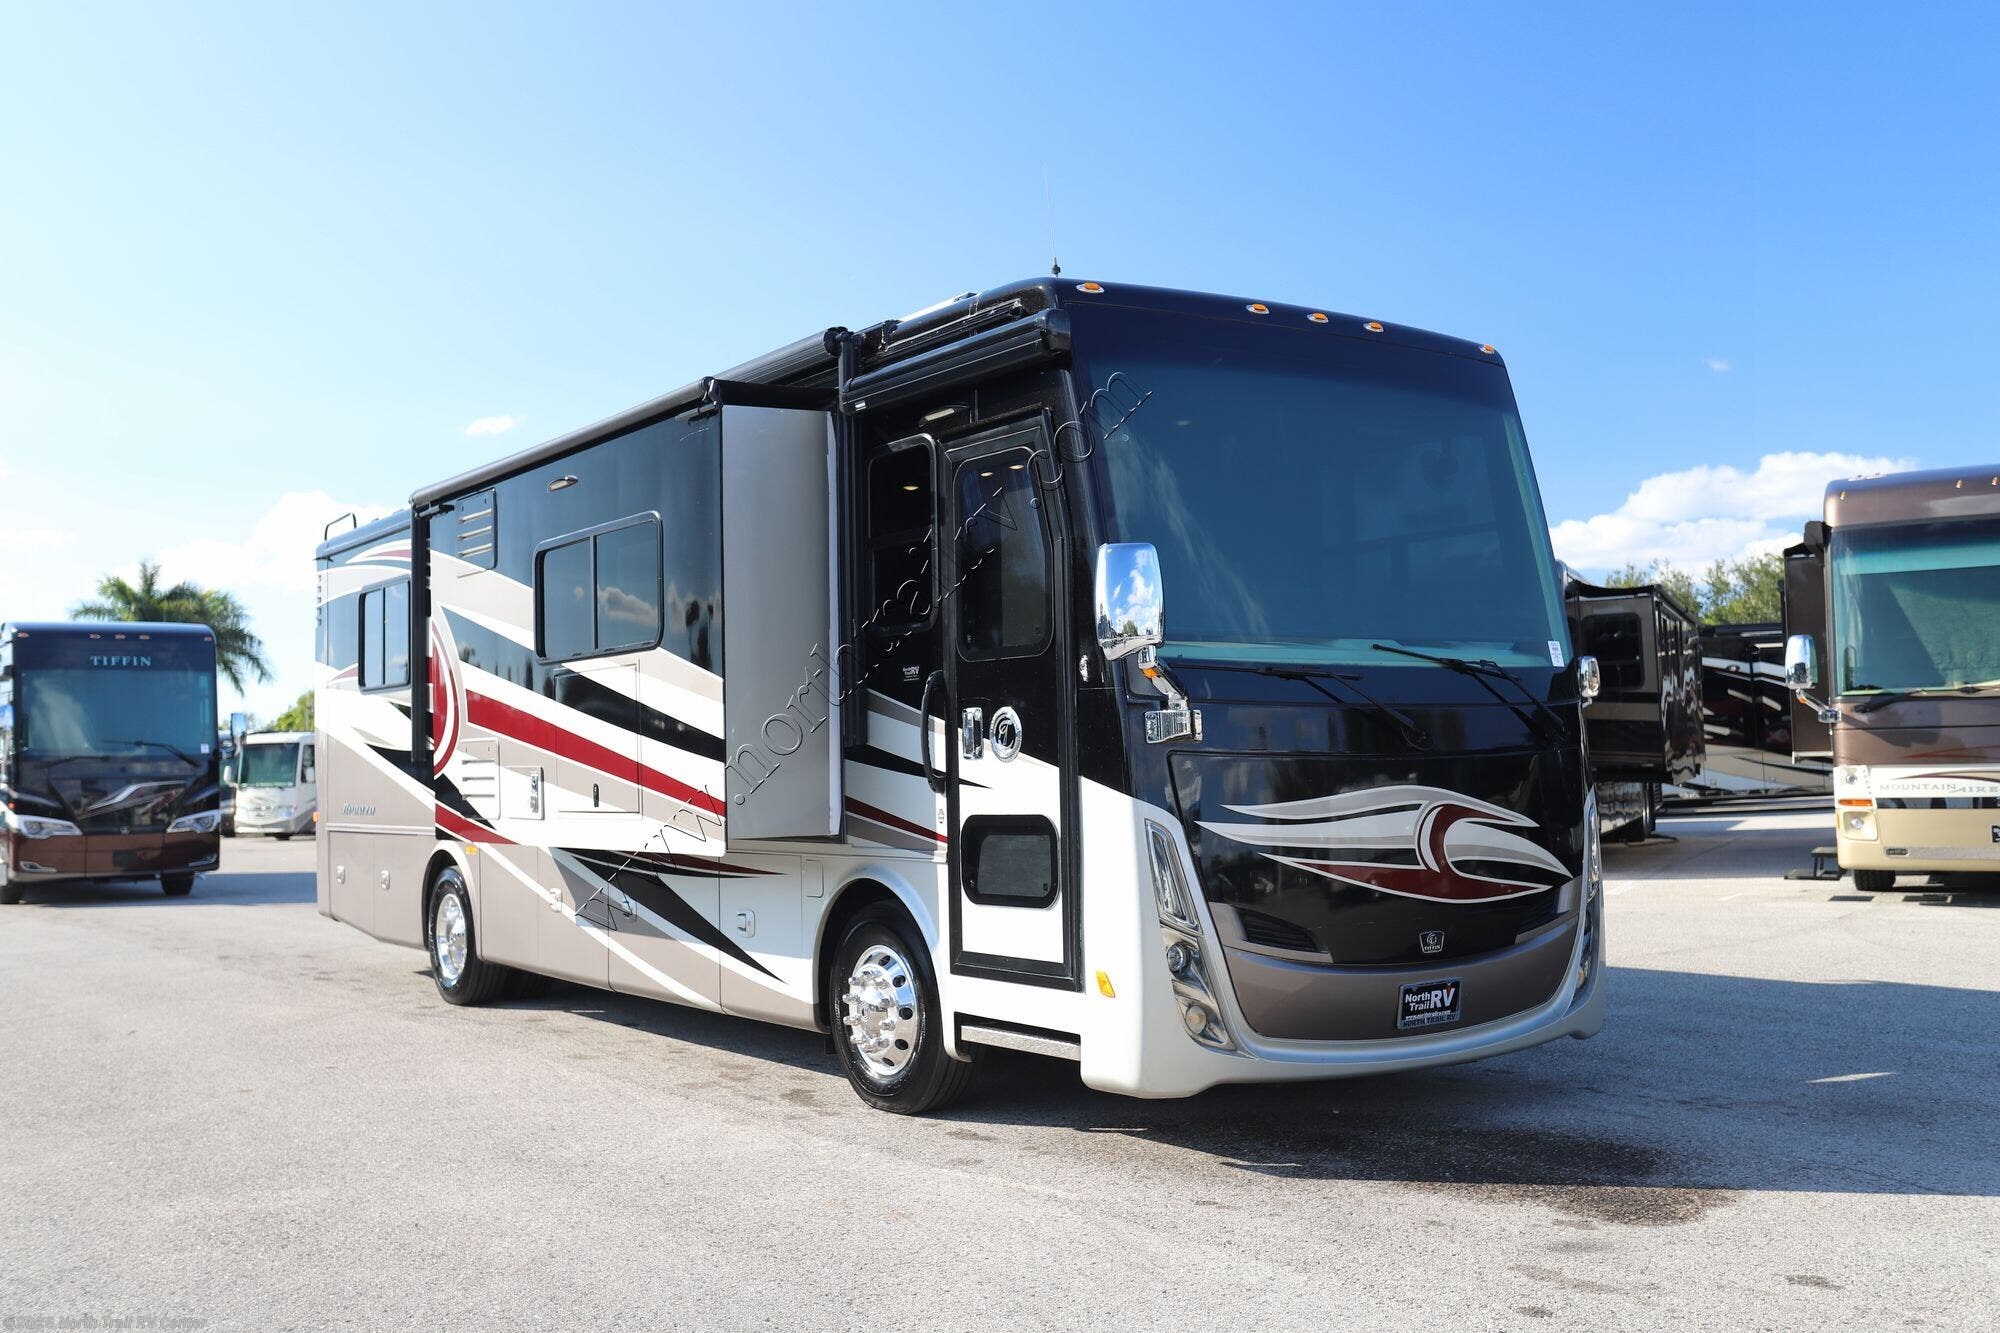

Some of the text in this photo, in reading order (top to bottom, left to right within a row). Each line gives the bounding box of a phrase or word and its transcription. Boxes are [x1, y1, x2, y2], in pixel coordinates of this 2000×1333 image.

[89, 655, 151, 666] TIFFIN
[1880, 783, 1957, 791] MOUNTAIN
[1405, 988, 1455, 1008] North RV
[1409, 1001, 1430, 1011] Trail
